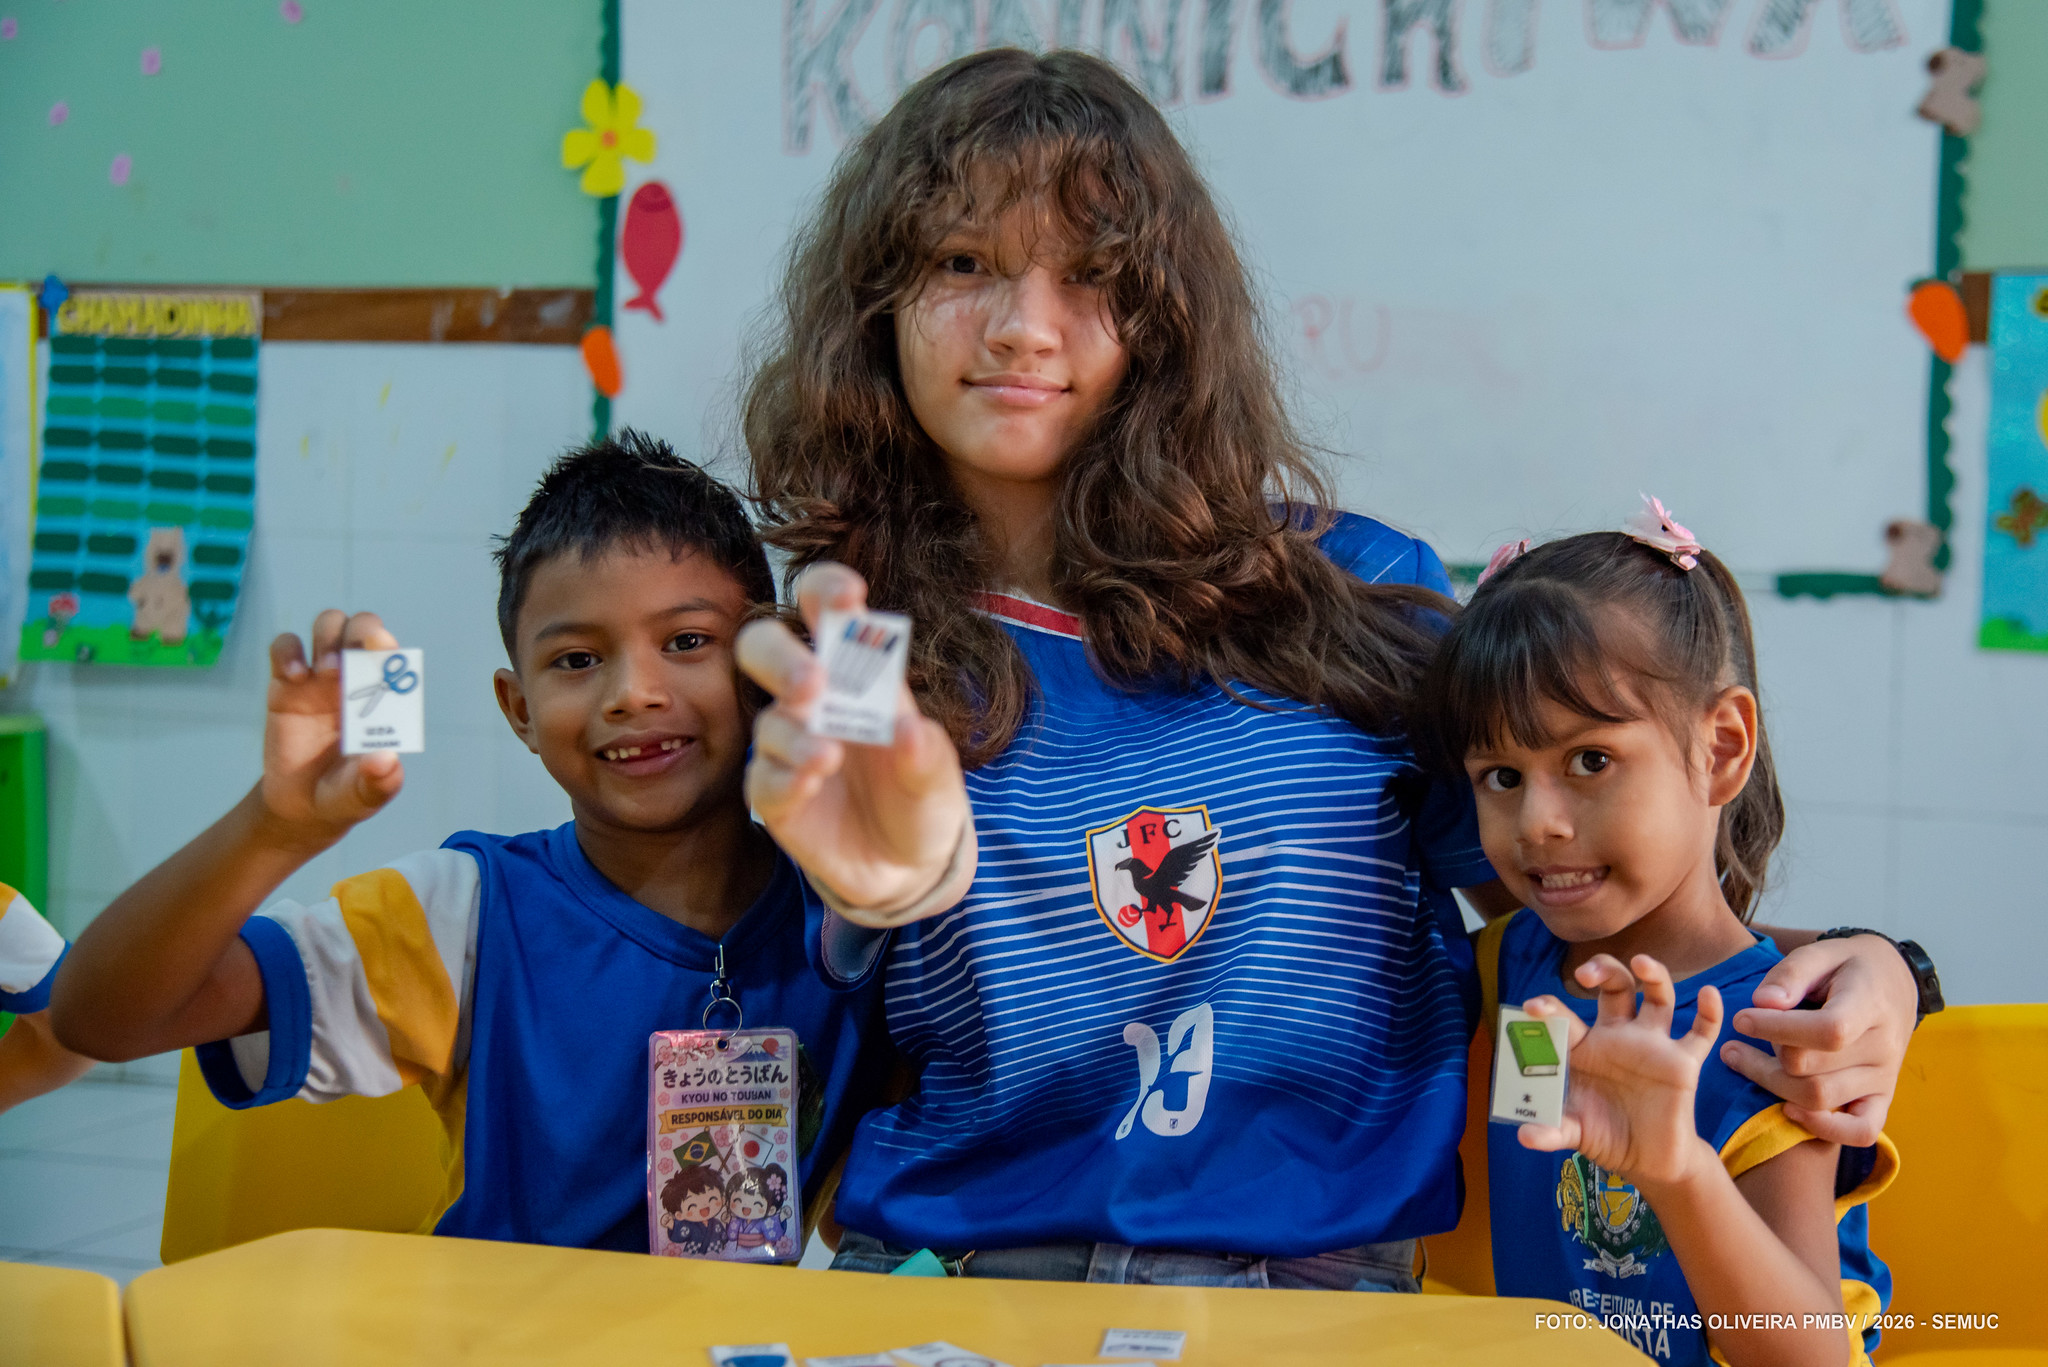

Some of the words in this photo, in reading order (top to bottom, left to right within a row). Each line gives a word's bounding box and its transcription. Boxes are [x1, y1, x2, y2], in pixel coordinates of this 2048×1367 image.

[663, 1064, 789, 1089] きょうのとうばん
[681, 1093, 710, 1104] KYOU
[713, 1091, 728, 1102] NO
[671, 1108, 746, 1125] RESPONSÁVEL
[748, 1109, 763, 1120] DO
[765, 1108, 783, 1120] DIA
[1515, 1107, 1537, 1119] HON
[1650, 1301, 1675, 1322] DE
